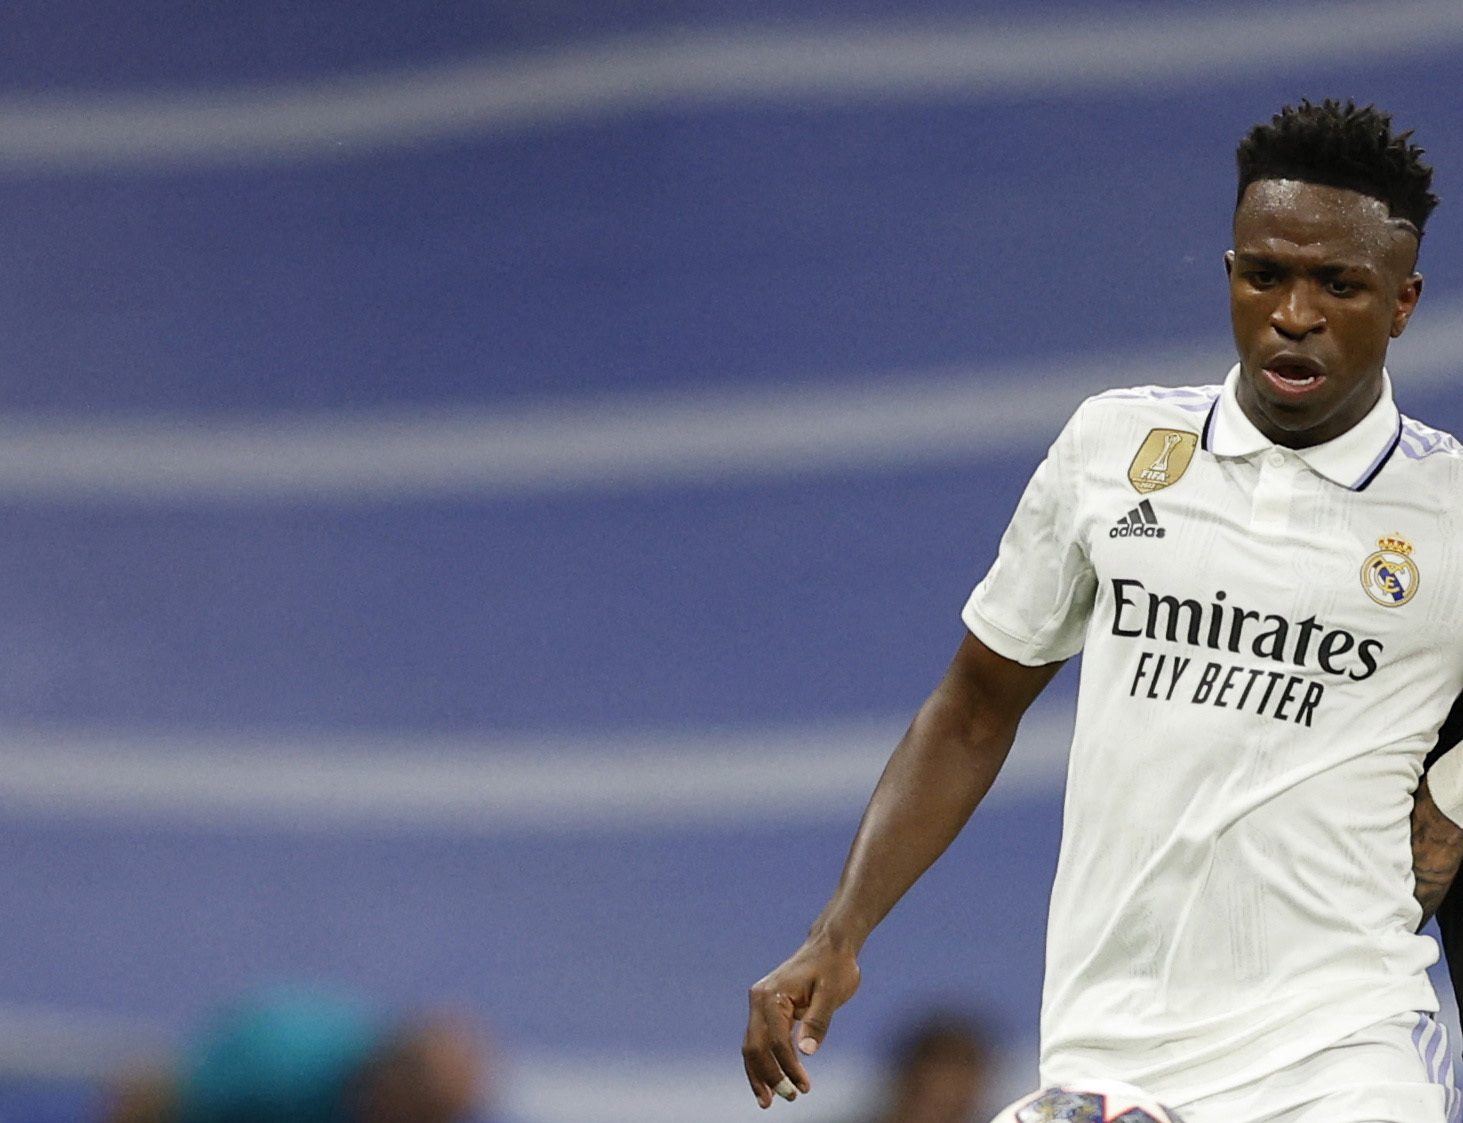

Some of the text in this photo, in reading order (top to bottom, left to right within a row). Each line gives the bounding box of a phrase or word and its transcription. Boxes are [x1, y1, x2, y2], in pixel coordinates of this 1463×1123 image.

[1140, 469, 1166, 481] FIFA
[1108, 522, 1166, 539] adidas
[1111, 578, 1384, 682] Emirates
[1129, 652, 1325, 728] FLY BETTER
